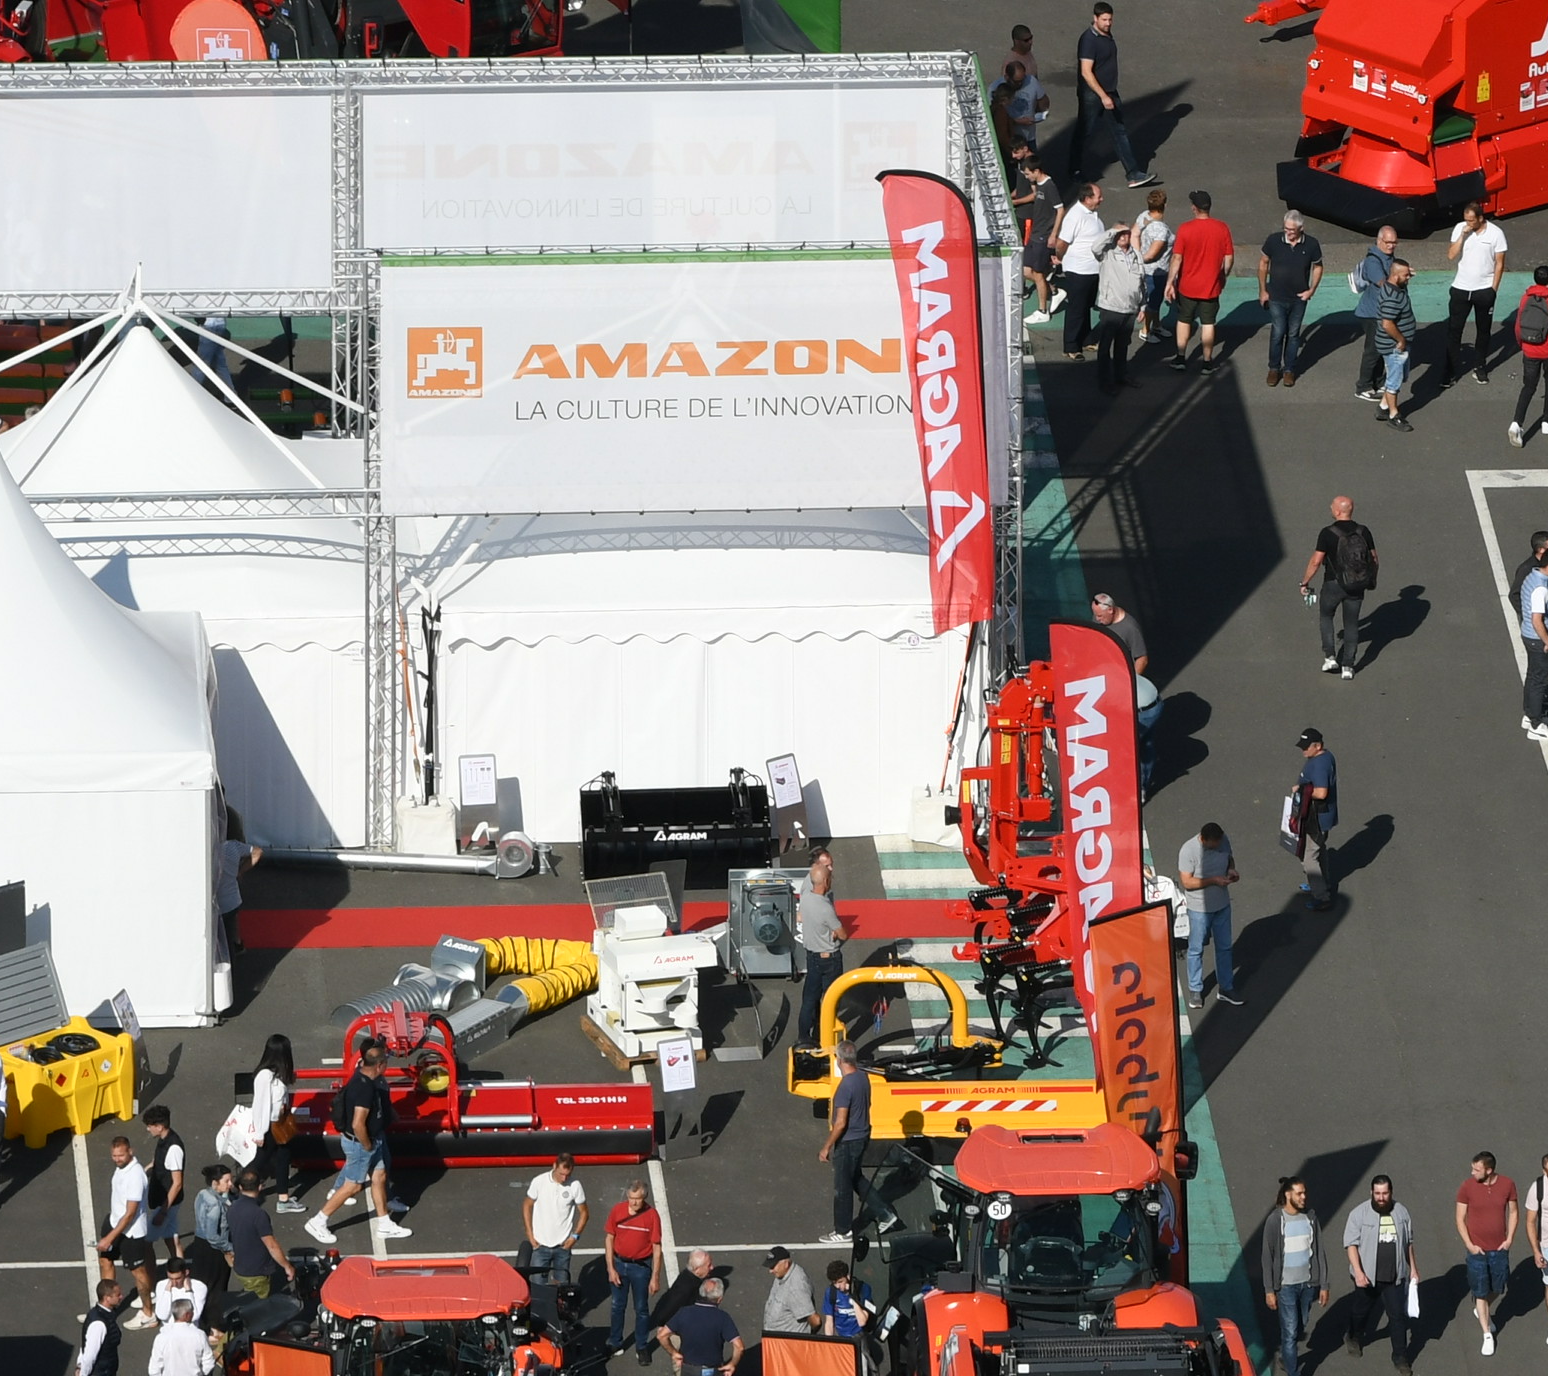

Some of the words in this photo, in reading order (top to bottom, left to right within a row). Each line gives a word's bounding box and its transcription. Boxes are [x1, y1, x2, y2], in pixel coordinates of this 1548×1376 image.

[512, 338, 902, 379] AMAZON
[408, 388, 482, 398] AMAZONE
[515, 400, 548, 421] LA
[557, 397, 676, 421] CULTURE
[688, 396, 722, 419] DE
[732, 394, 914, 418] L'INNOVATION
[667, 832, 707, 842] AGRAM
[452, 940, 479, 954] AGRAM
[664, 955, 694, 964] AGRAM
[887, 971, 917, 980] AGRAM
[992, 1204, 1007, 1215] 50
